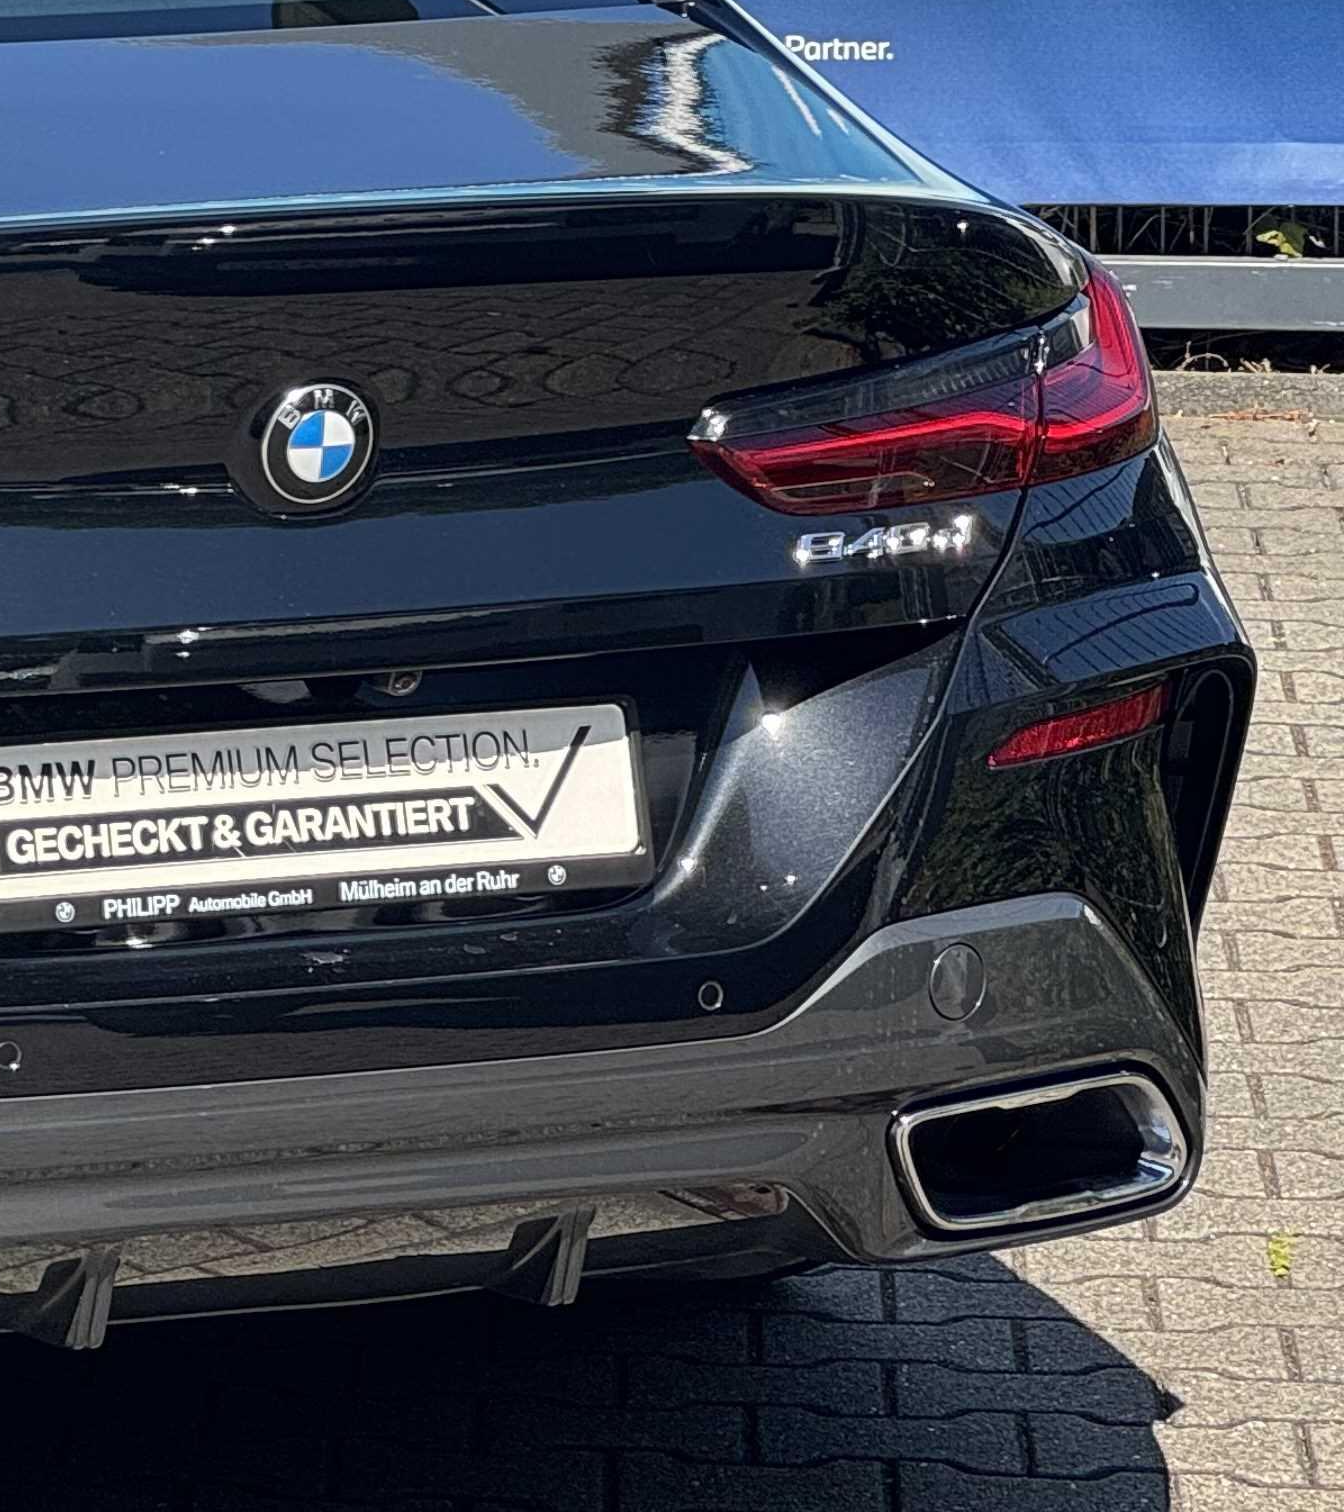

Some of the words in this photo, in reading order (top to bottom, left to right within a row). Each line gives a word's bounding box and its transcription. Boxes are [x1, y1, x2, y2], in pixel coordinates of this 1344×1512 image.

[785, 35, 894, 60] Partner.
[278, 388, 367, 430] BMW
[113, 744, 300, 796] PREMIUM
[311, 729, 540, 783] SELECTION.
[7, 815, 209, 864] GECHECKT
[214, 814, 241, 848] &
[245, 796, 476, 845] GARANTIERT
[103, 894, 180, 919] PHILIPP
[188, 893, 266, 913] Automobile
[268, 889, 313, 907] GmbH
[339, 877, 418, 902] Mülheim
[419, 881, 442, 895] an
[445, 874, 474, 893] der
[476, 870, 520, 890] Ruhr
